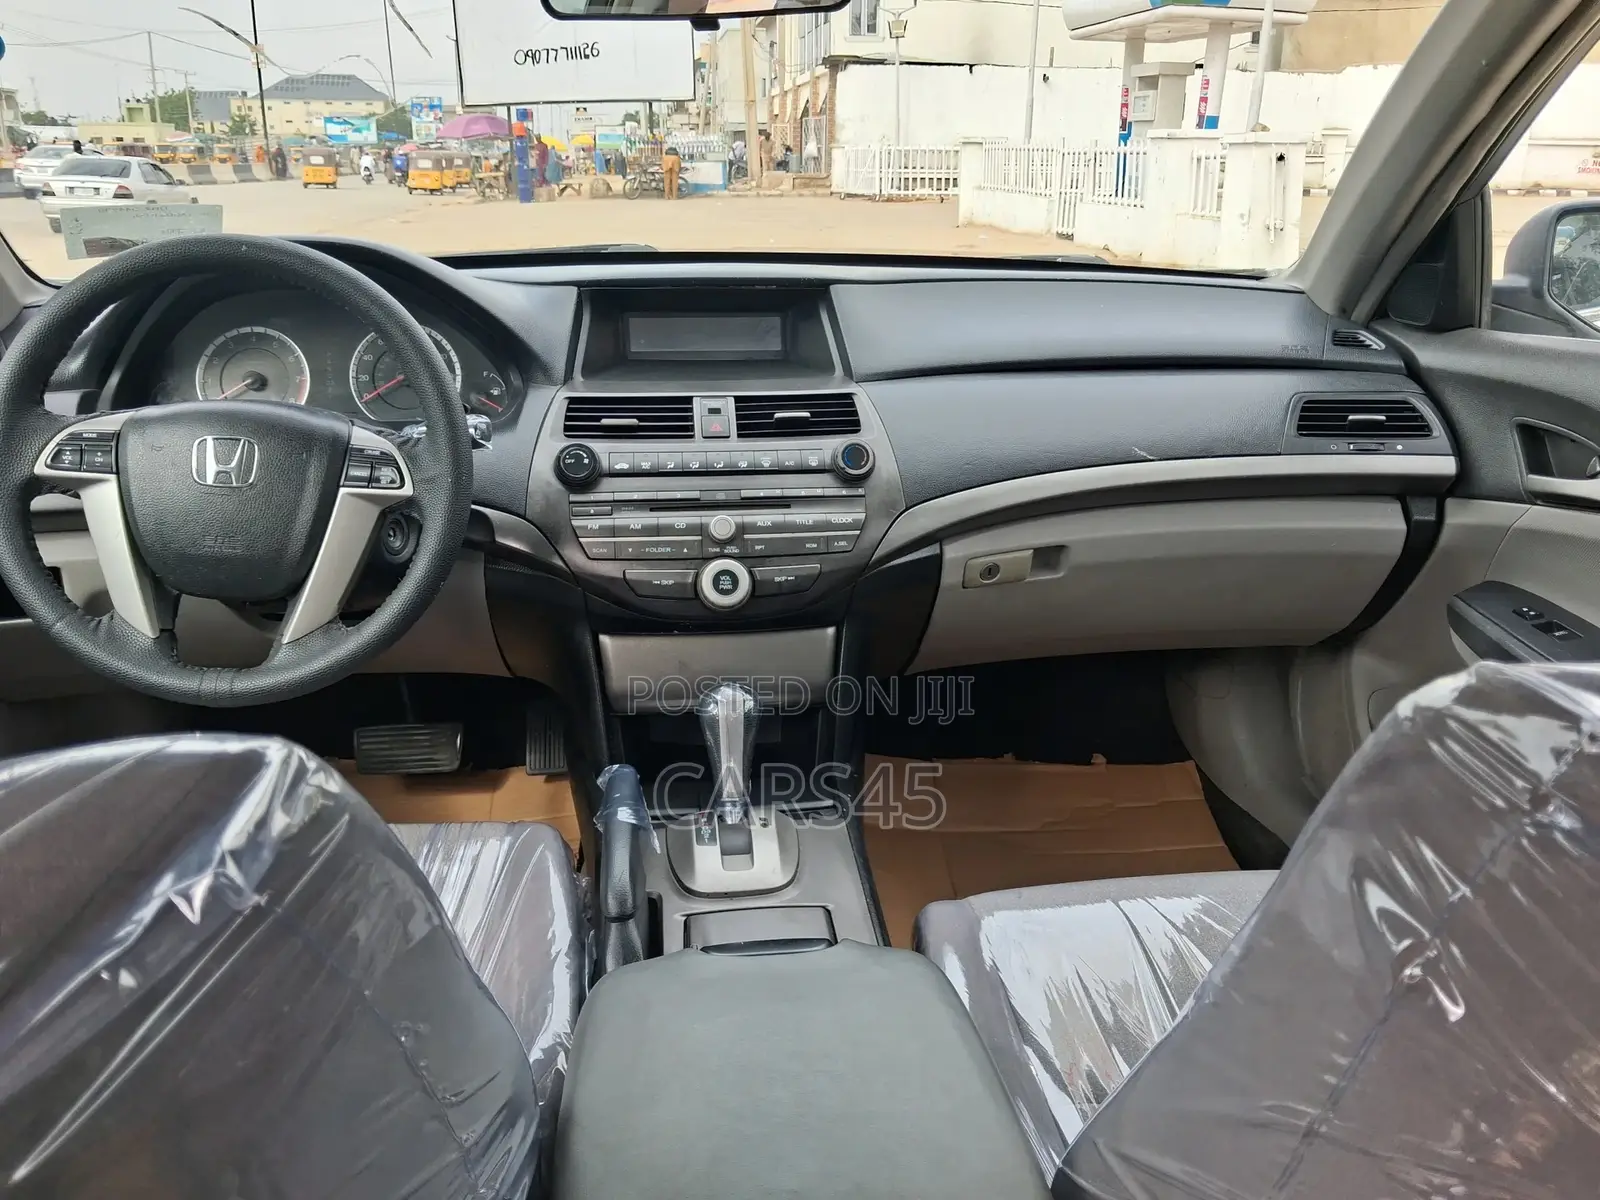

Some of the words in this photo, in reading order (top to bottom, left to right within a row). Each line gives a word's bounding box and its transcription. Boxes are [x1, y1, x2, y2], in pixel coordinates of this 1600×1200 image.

[362, 353, 373, 361] 40
[358, 374, 370, 382] 20
[674, 521, 687, 529] CD
[756, 520, 773, 528] AUX
[795, 518, 814, 526] TITLE
[774, 575, 788, 583] SKIP
